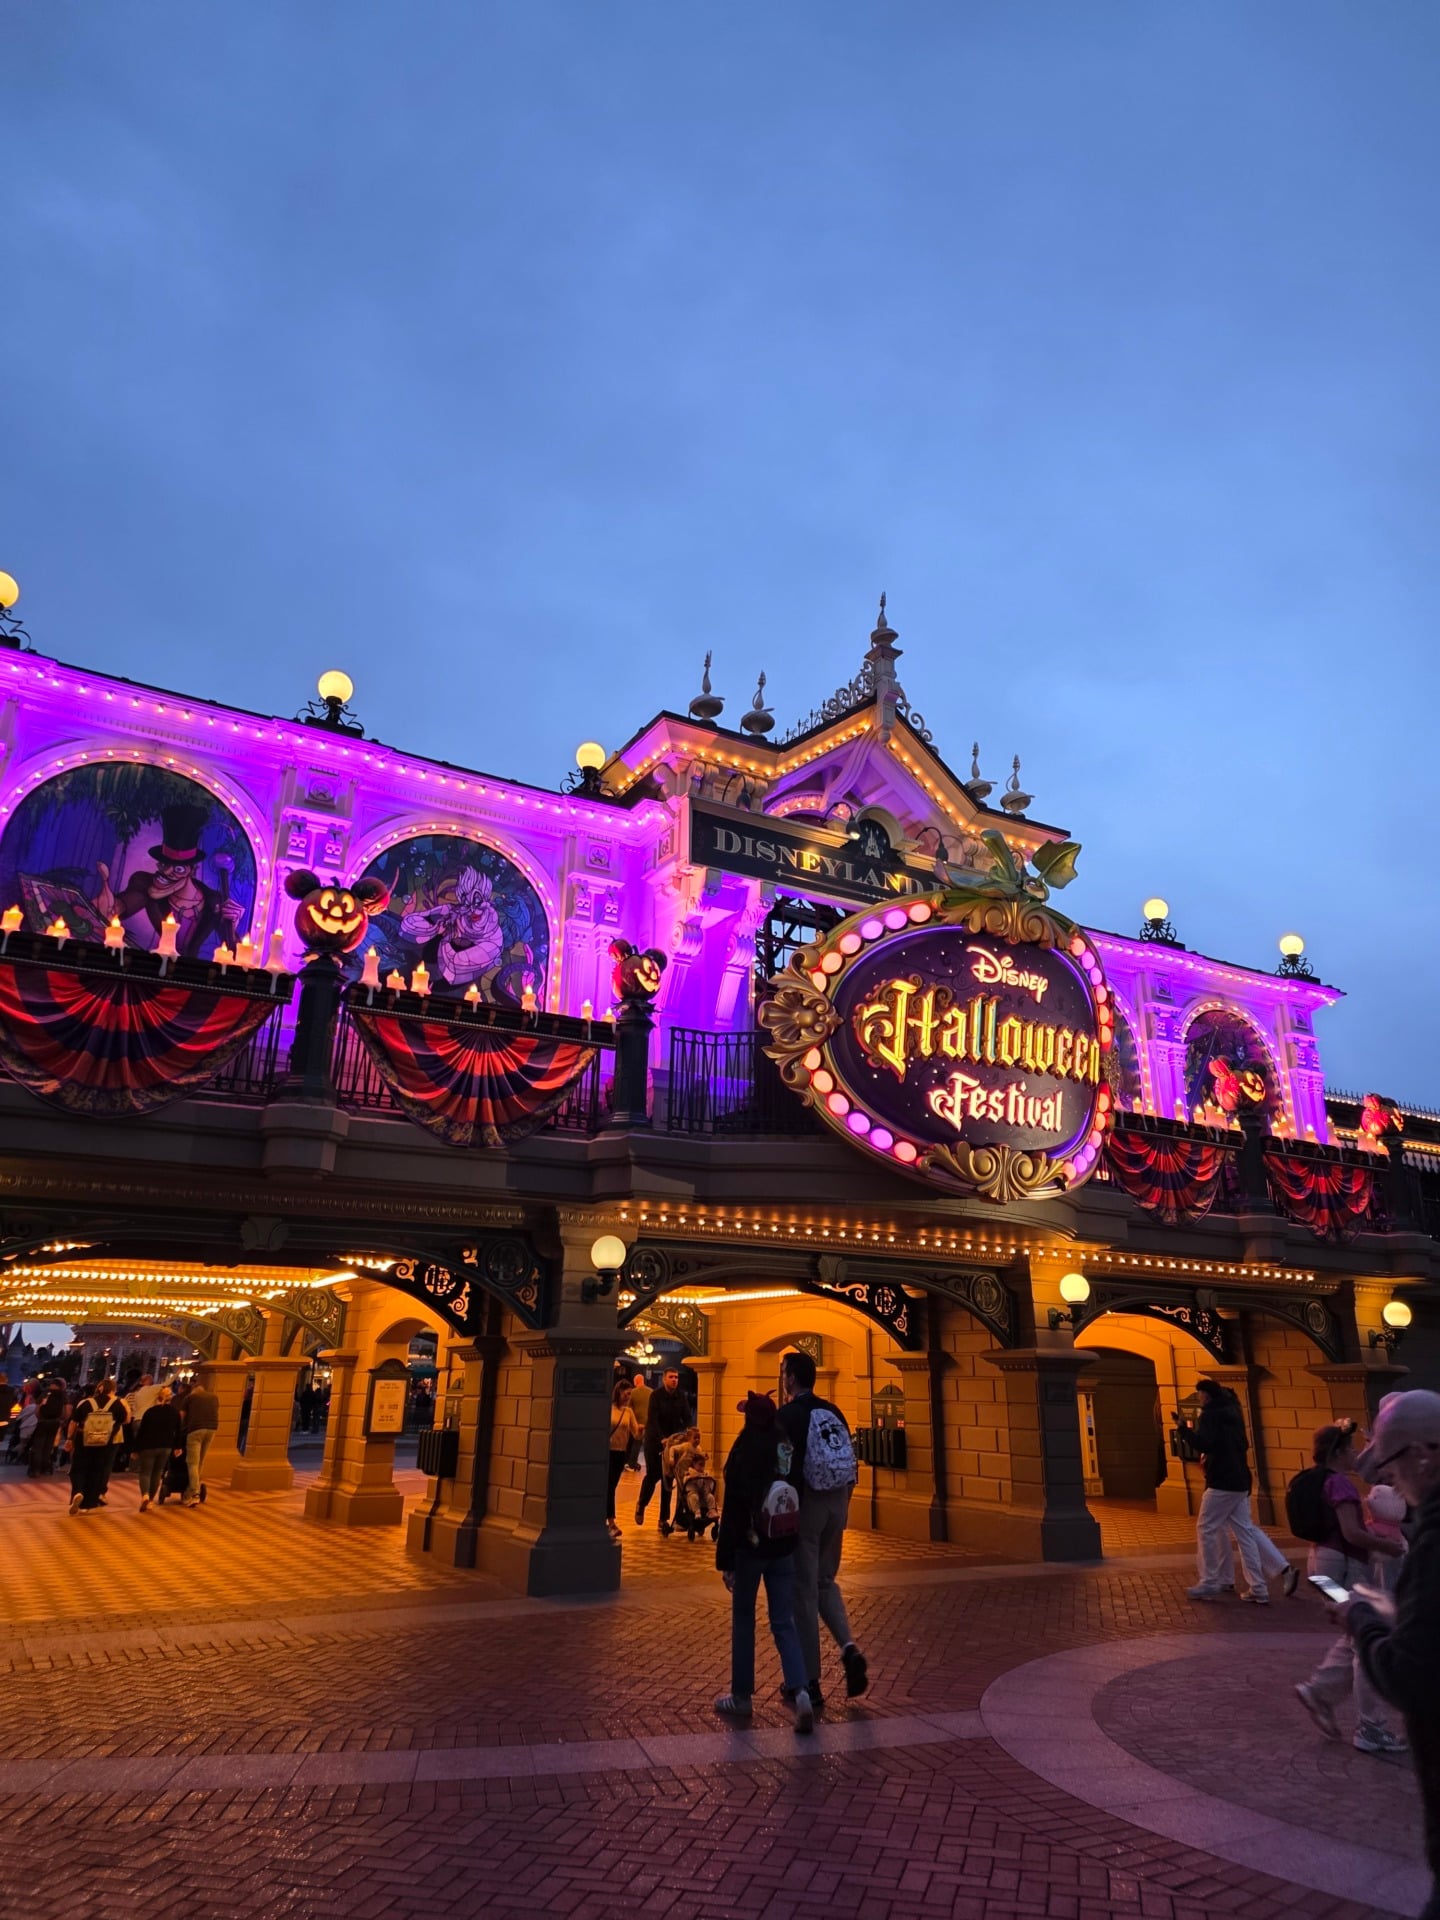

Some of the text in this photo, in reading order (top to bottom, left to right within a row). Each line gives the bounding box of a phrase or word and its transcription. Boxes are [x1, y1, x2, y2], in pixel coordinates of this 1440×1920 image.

[713, 827, 923, 895] DISNEYLAND
[966, 946, 1048, 1003] Disney
[858, 978, 1100, 1085] Halloween
[929, 1072, 1063, 1133] Festival
